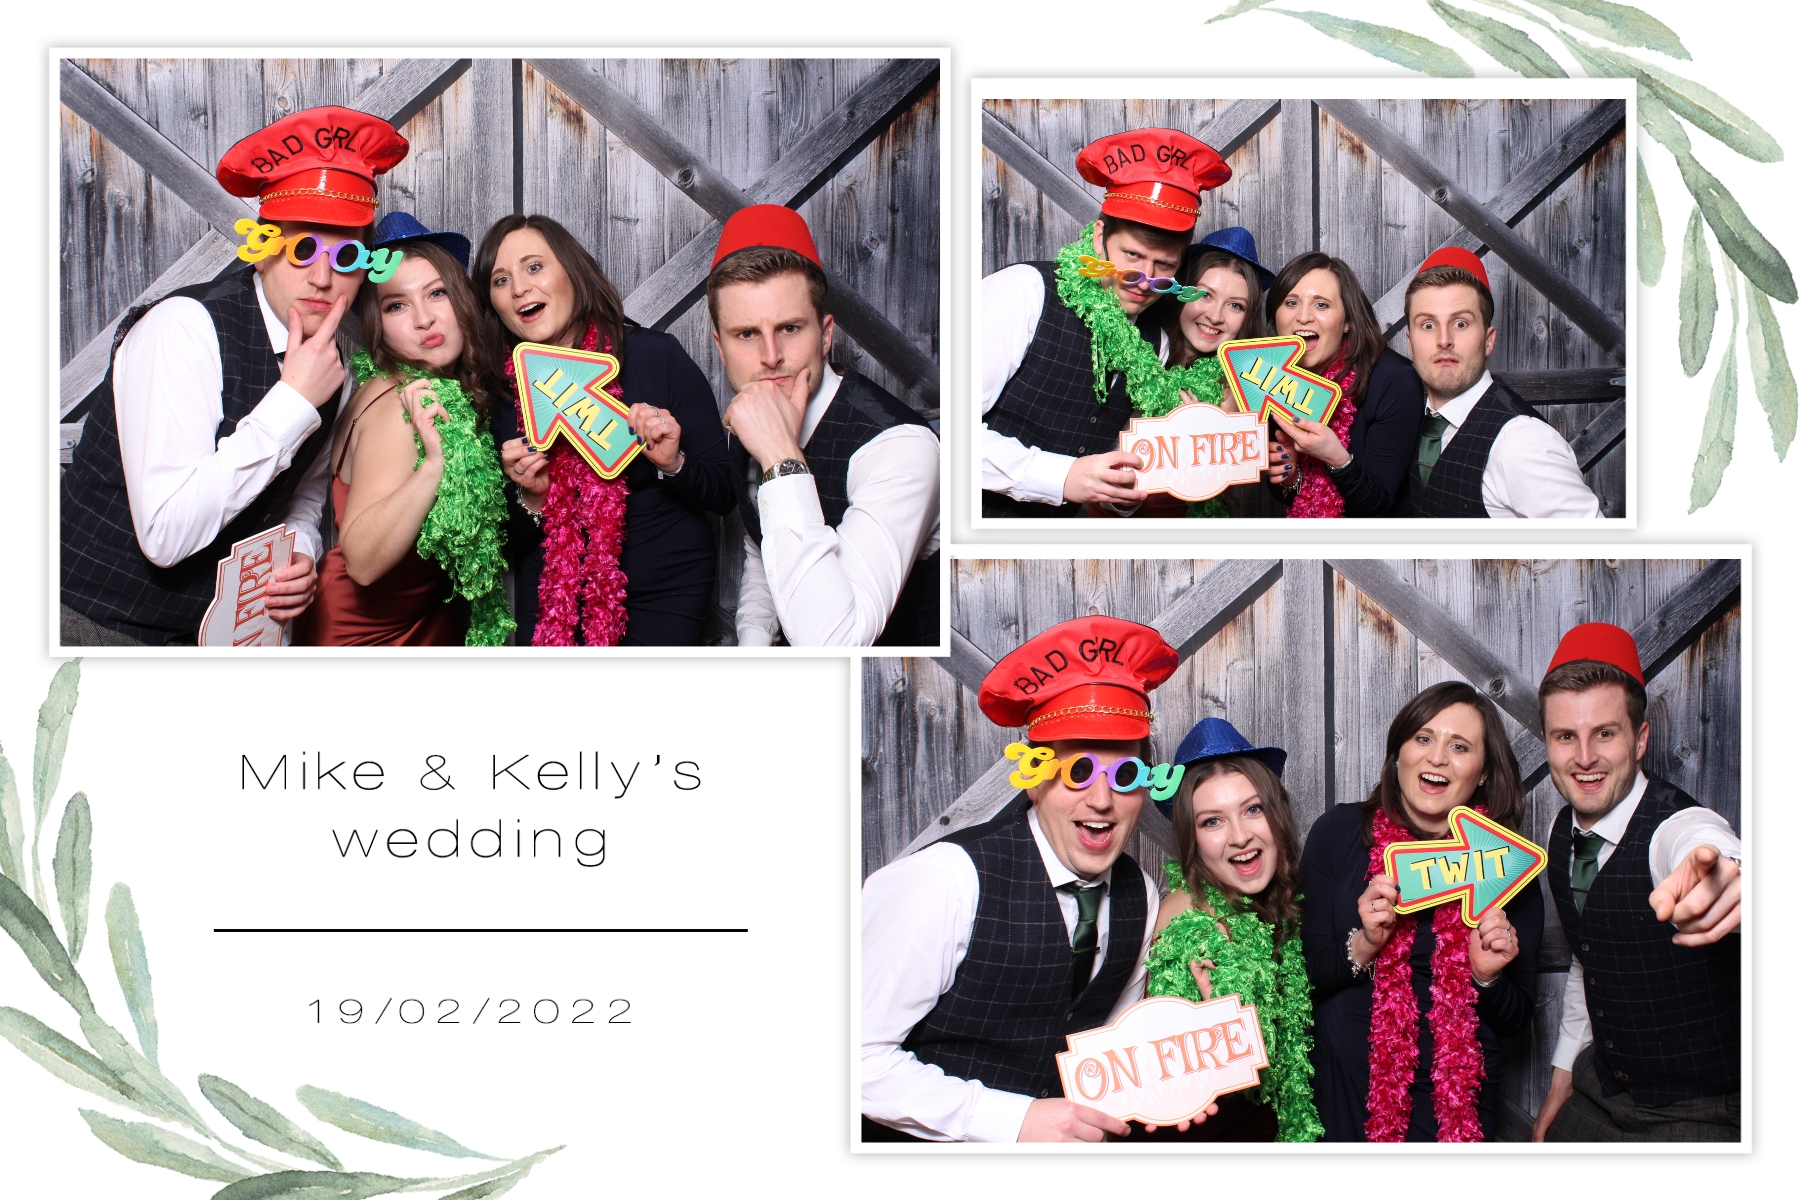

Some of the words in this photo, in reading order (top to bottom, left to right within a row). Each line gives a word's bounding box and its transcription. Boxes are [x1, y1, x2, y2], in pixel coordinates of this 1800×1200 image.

[251, 134, 304, 173] BAD
[314, 125, 360, 153] GRL
[1103, 144, 1147, 174] BAD
[1156, 145, 1193, 171] GRL
[531, 368, 619, 451] TWIT
[1240, 357, 1315, 416] TWIT
[1130, 435, 1182, 473] ON
[1188, 429, 1261, 468] FIRE
[233, 541, 274, 634] FIRE
[1013, 649, 1069, 695] BAD
[1078, 636, 1126, 666] GRL
[1410, 846, 1510, 890] TWIT
[1075, 1046, 1143, 1101] ON
[1147, 1017, 1254, 1082] FIRE
